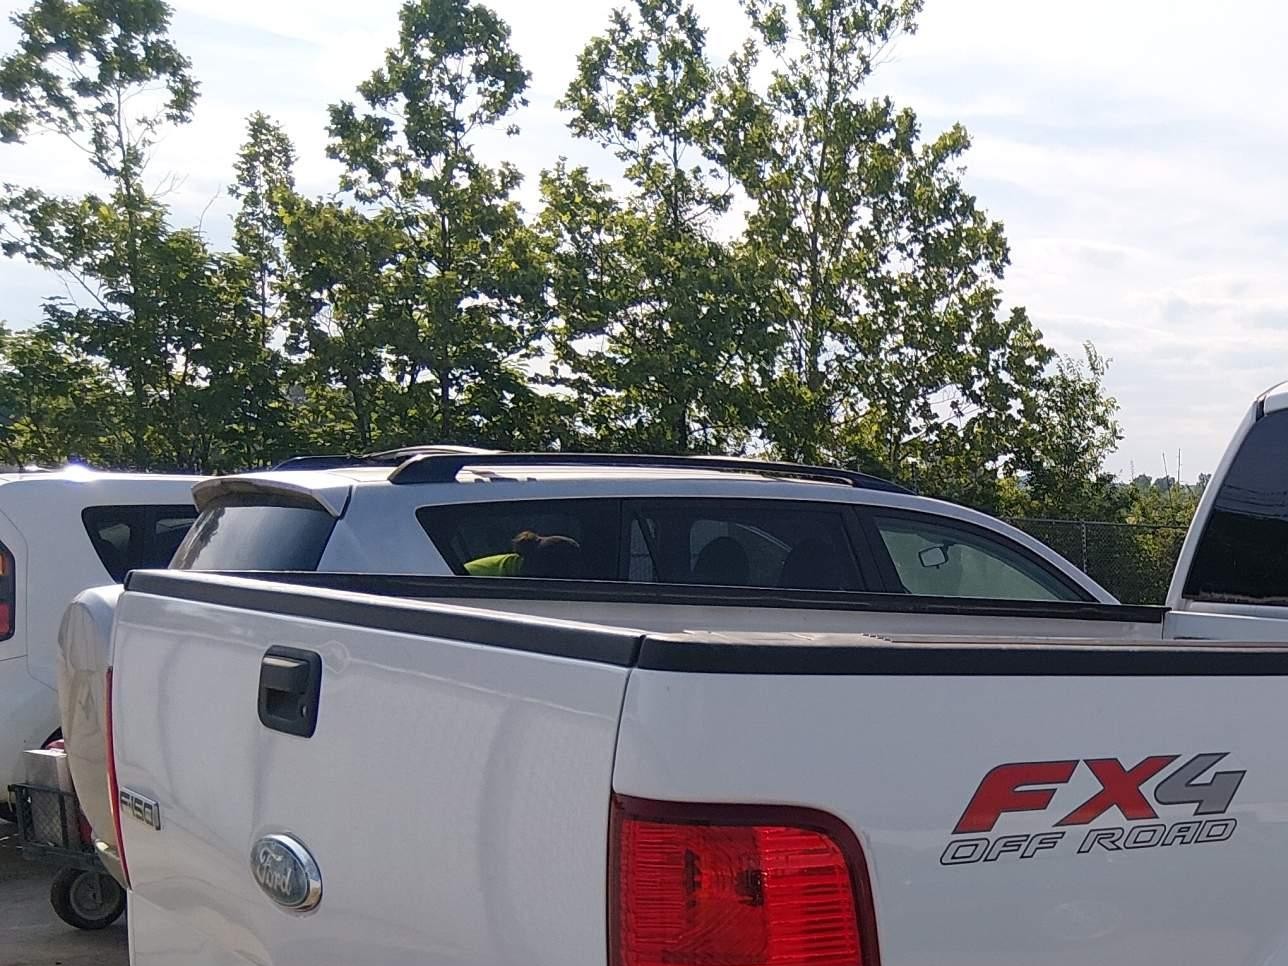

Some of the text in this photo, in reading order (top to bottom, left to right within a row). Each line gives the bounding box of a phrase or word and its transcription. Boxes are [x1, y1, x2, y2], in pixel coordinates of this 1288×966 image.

[951, 752, 1247, 834] FX4
[939, 818, 1237, 865] OFF ROAD
[256, 847, 293, 896] Ford
